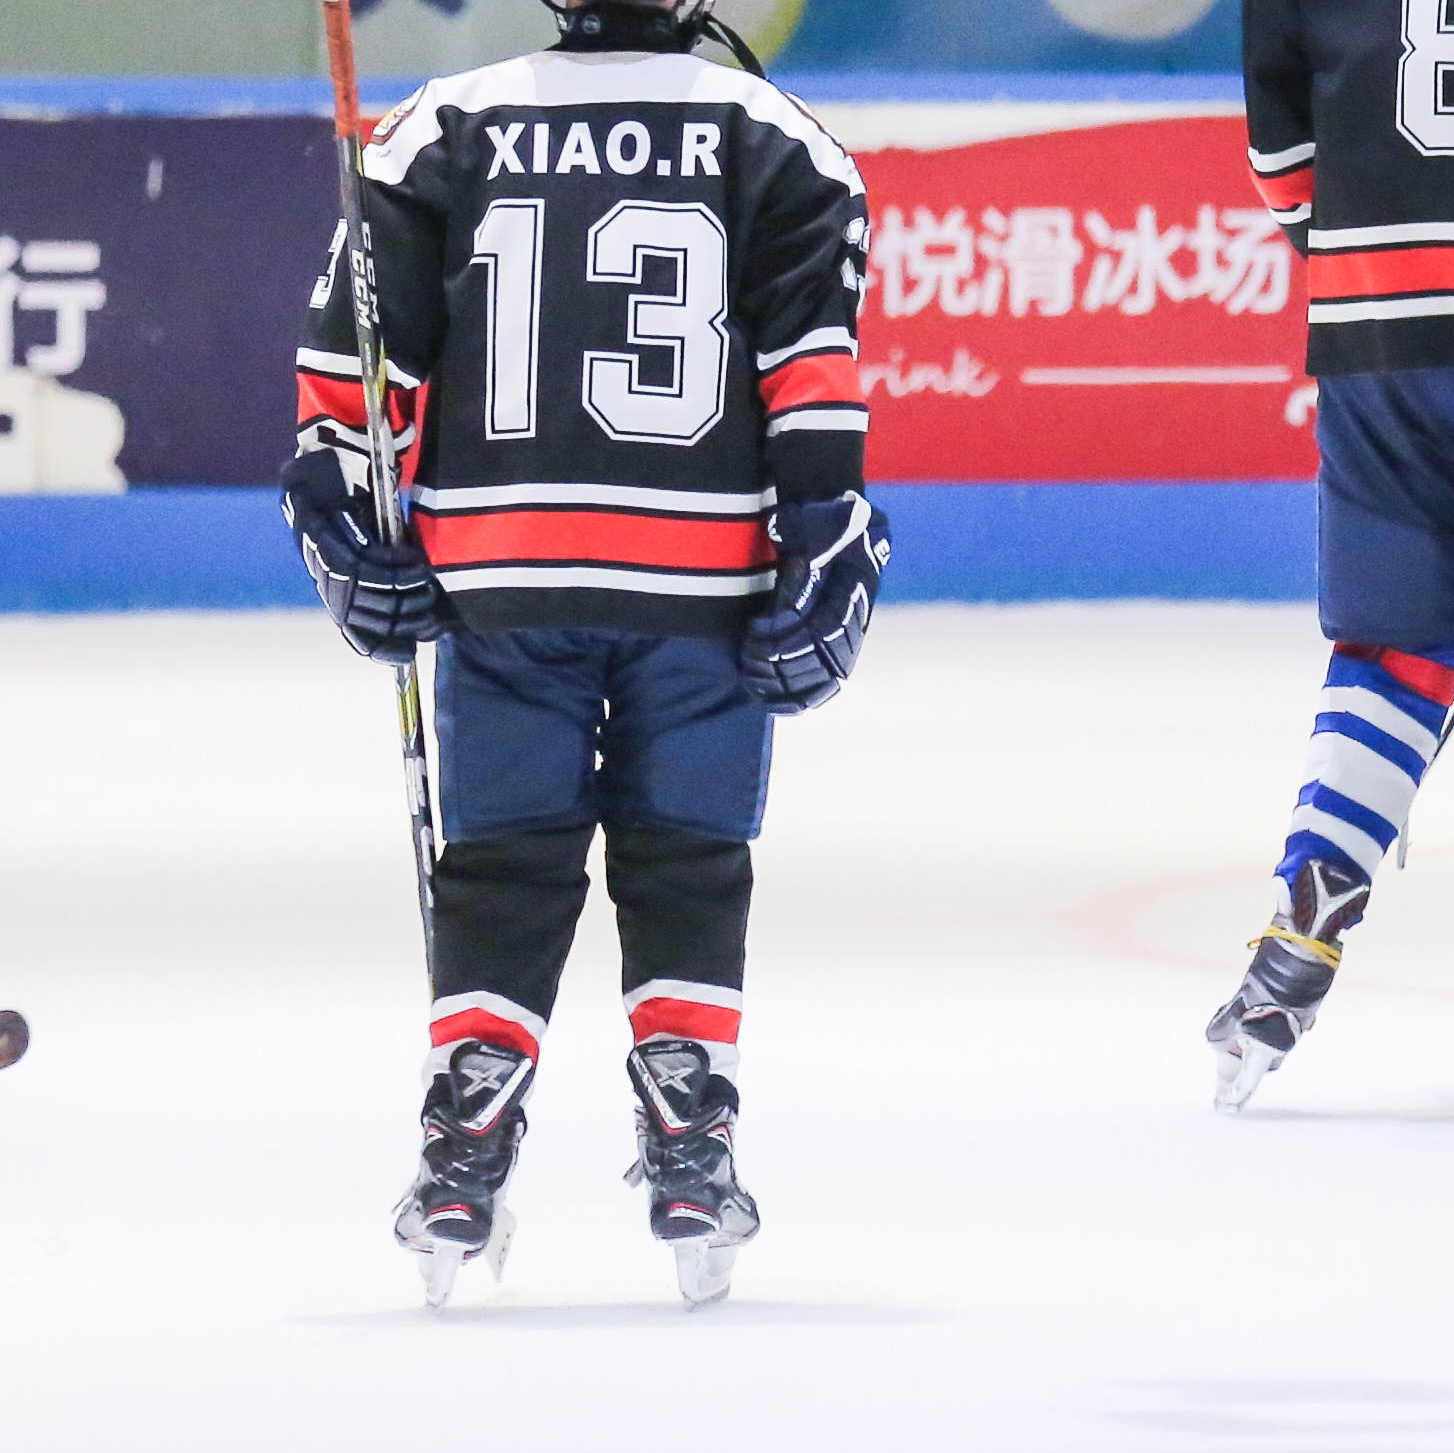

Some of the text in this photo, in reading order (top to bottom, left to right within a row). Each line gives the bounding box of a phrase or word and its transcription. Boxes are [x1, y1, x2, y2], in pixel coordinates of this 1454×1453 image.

[485, 121, 723, 180] XIAO.R
[866, 203, 1292, 318] 悦滑冰场
[469, 198, 730, 446] 13
